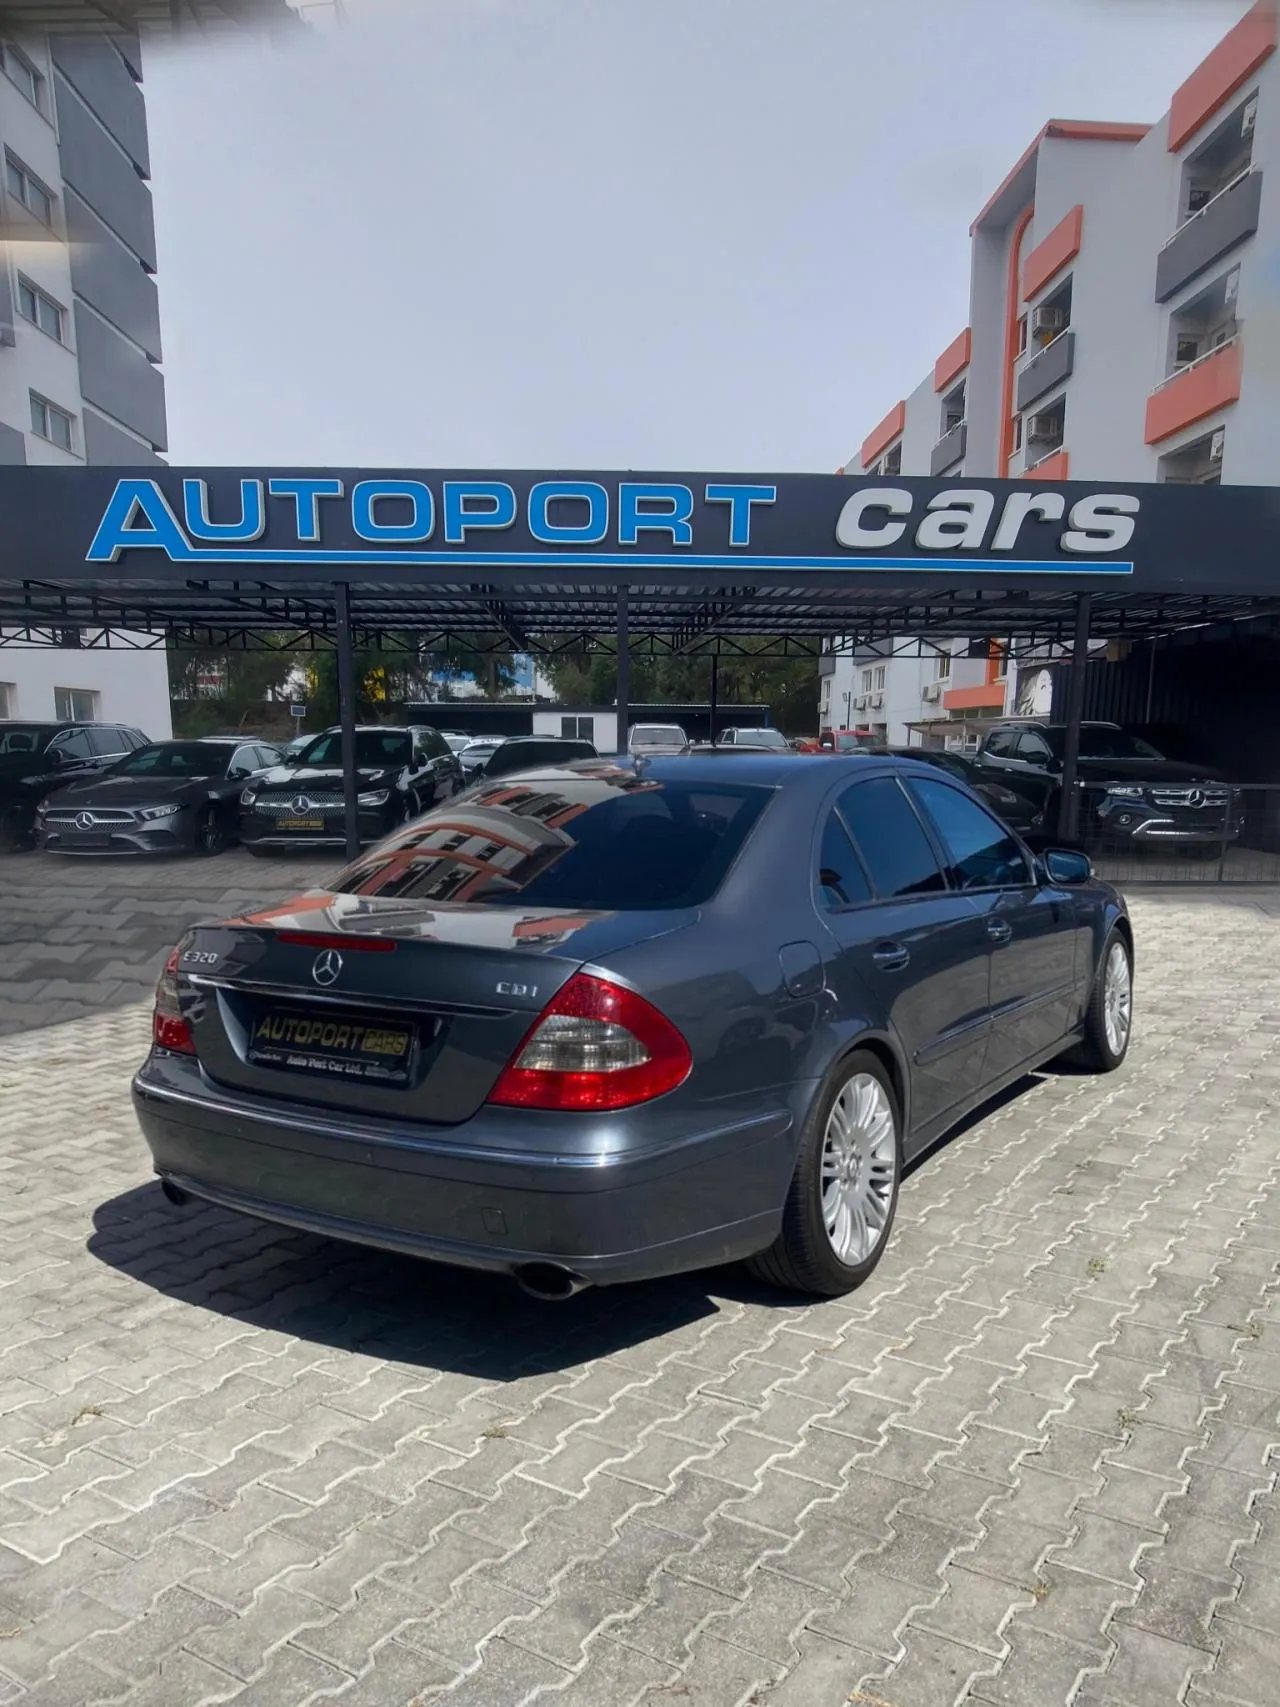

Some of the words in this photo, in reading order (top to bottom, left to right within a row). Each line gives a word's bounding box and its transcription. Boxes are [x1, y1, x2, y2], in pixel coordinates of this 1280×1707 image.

[85, 479, 777, 562] AUTOPORT
[183, 950, 218, 964] E320
[496, 981, 538, 997] CDI
[257, 1016, 364, 1050] AUTOPORT
[365, 1030, 405, 1054] CARS
